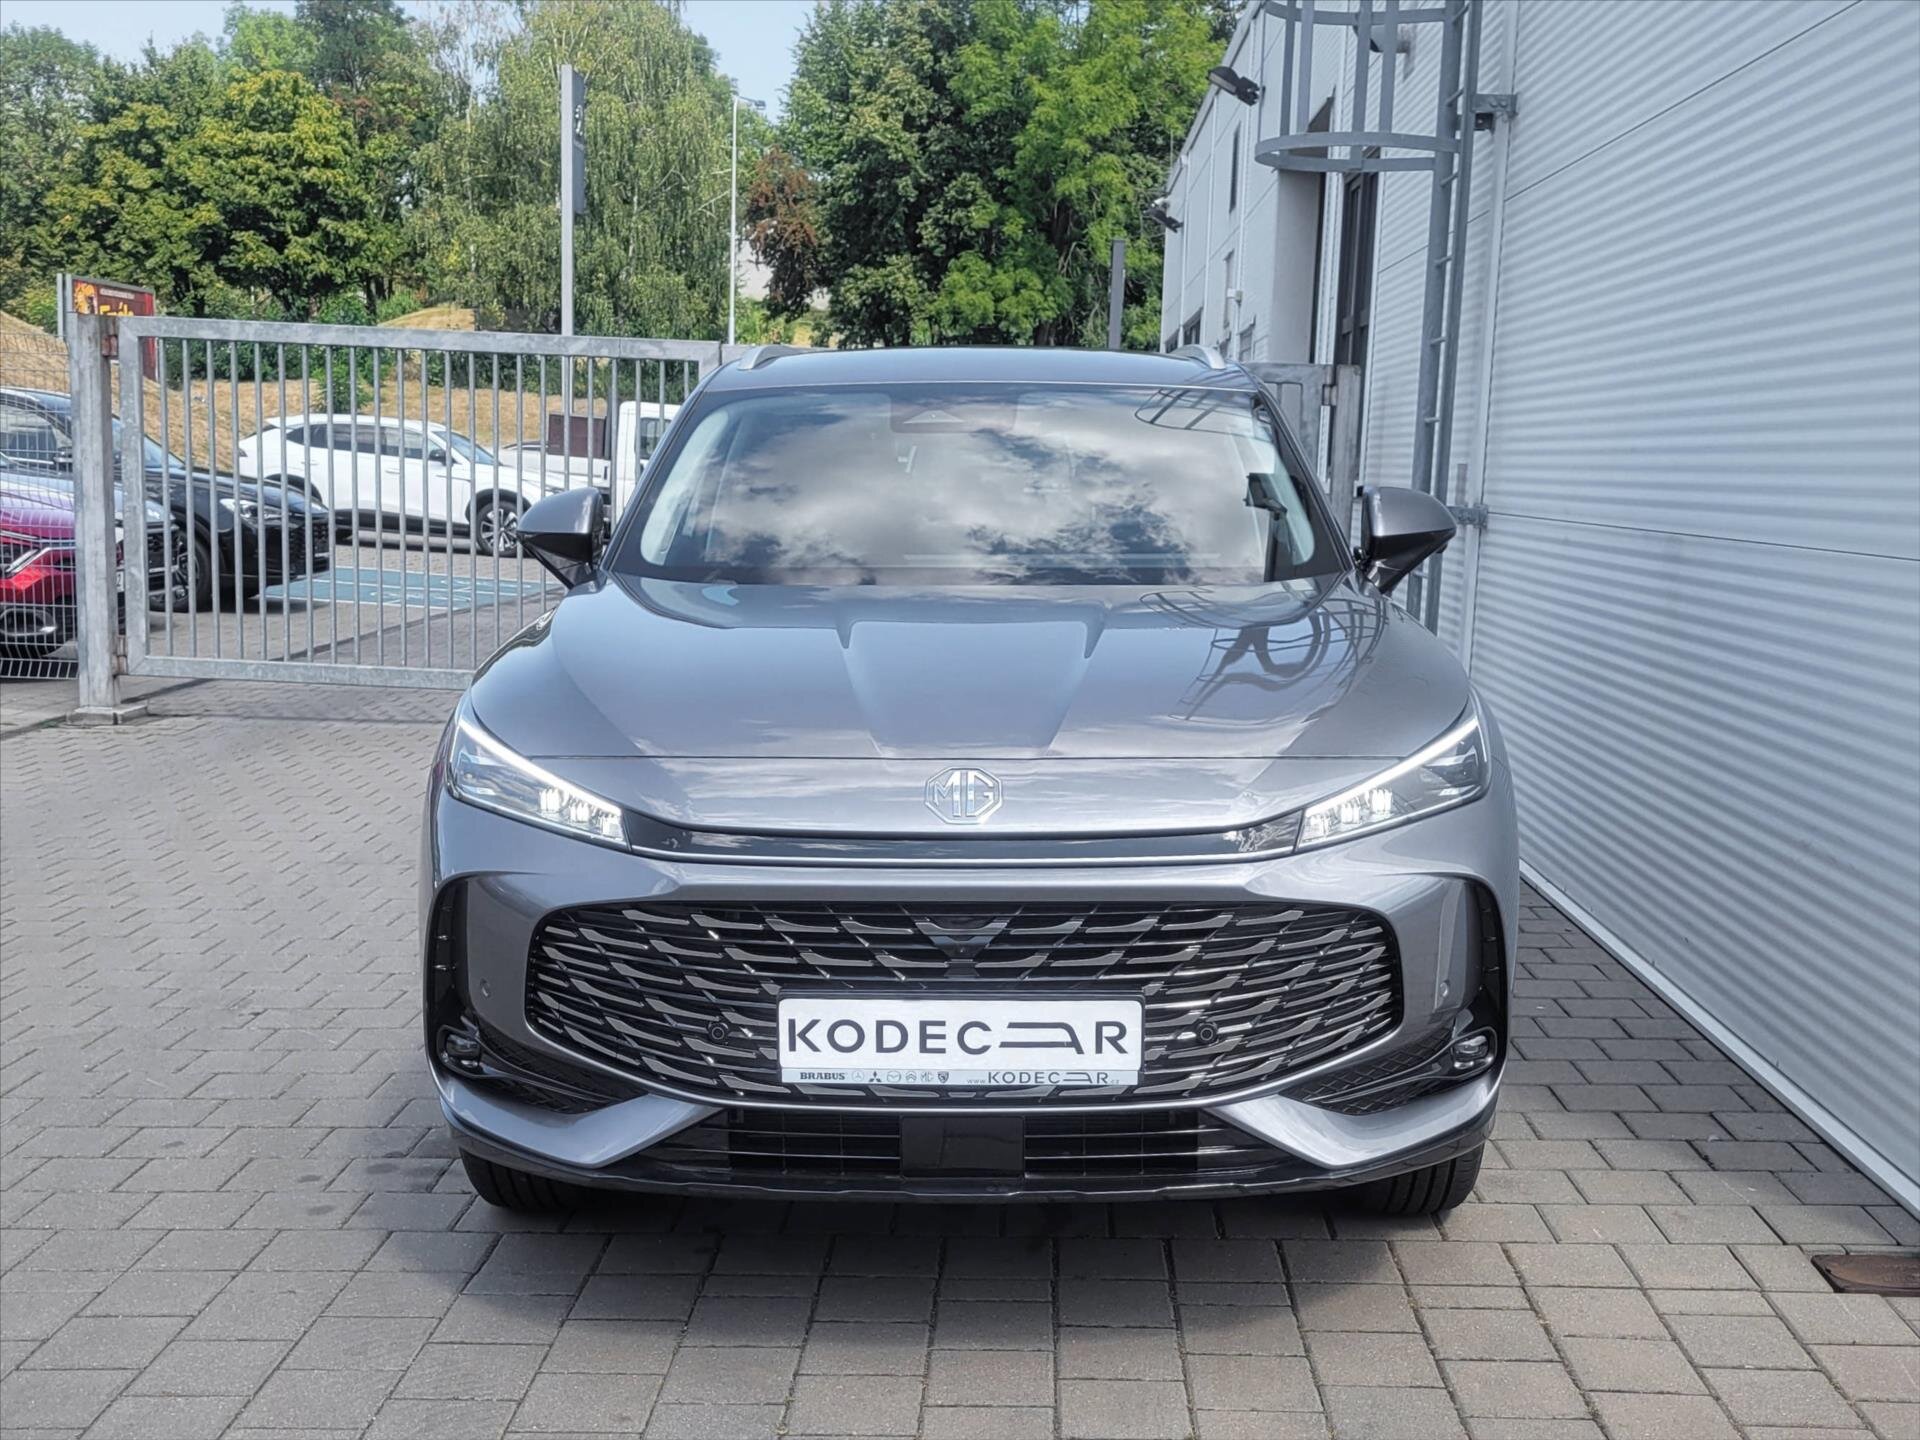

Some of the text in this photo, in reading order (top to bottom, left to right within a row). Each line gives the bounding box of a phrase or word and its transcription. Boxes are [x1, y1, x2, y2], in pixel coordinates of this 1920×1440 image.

[932, 770, 995, 817] MG
[787, 1018, 1129, 1055] KODECAR
[799, 1072, 845, 1080] BRABUS
